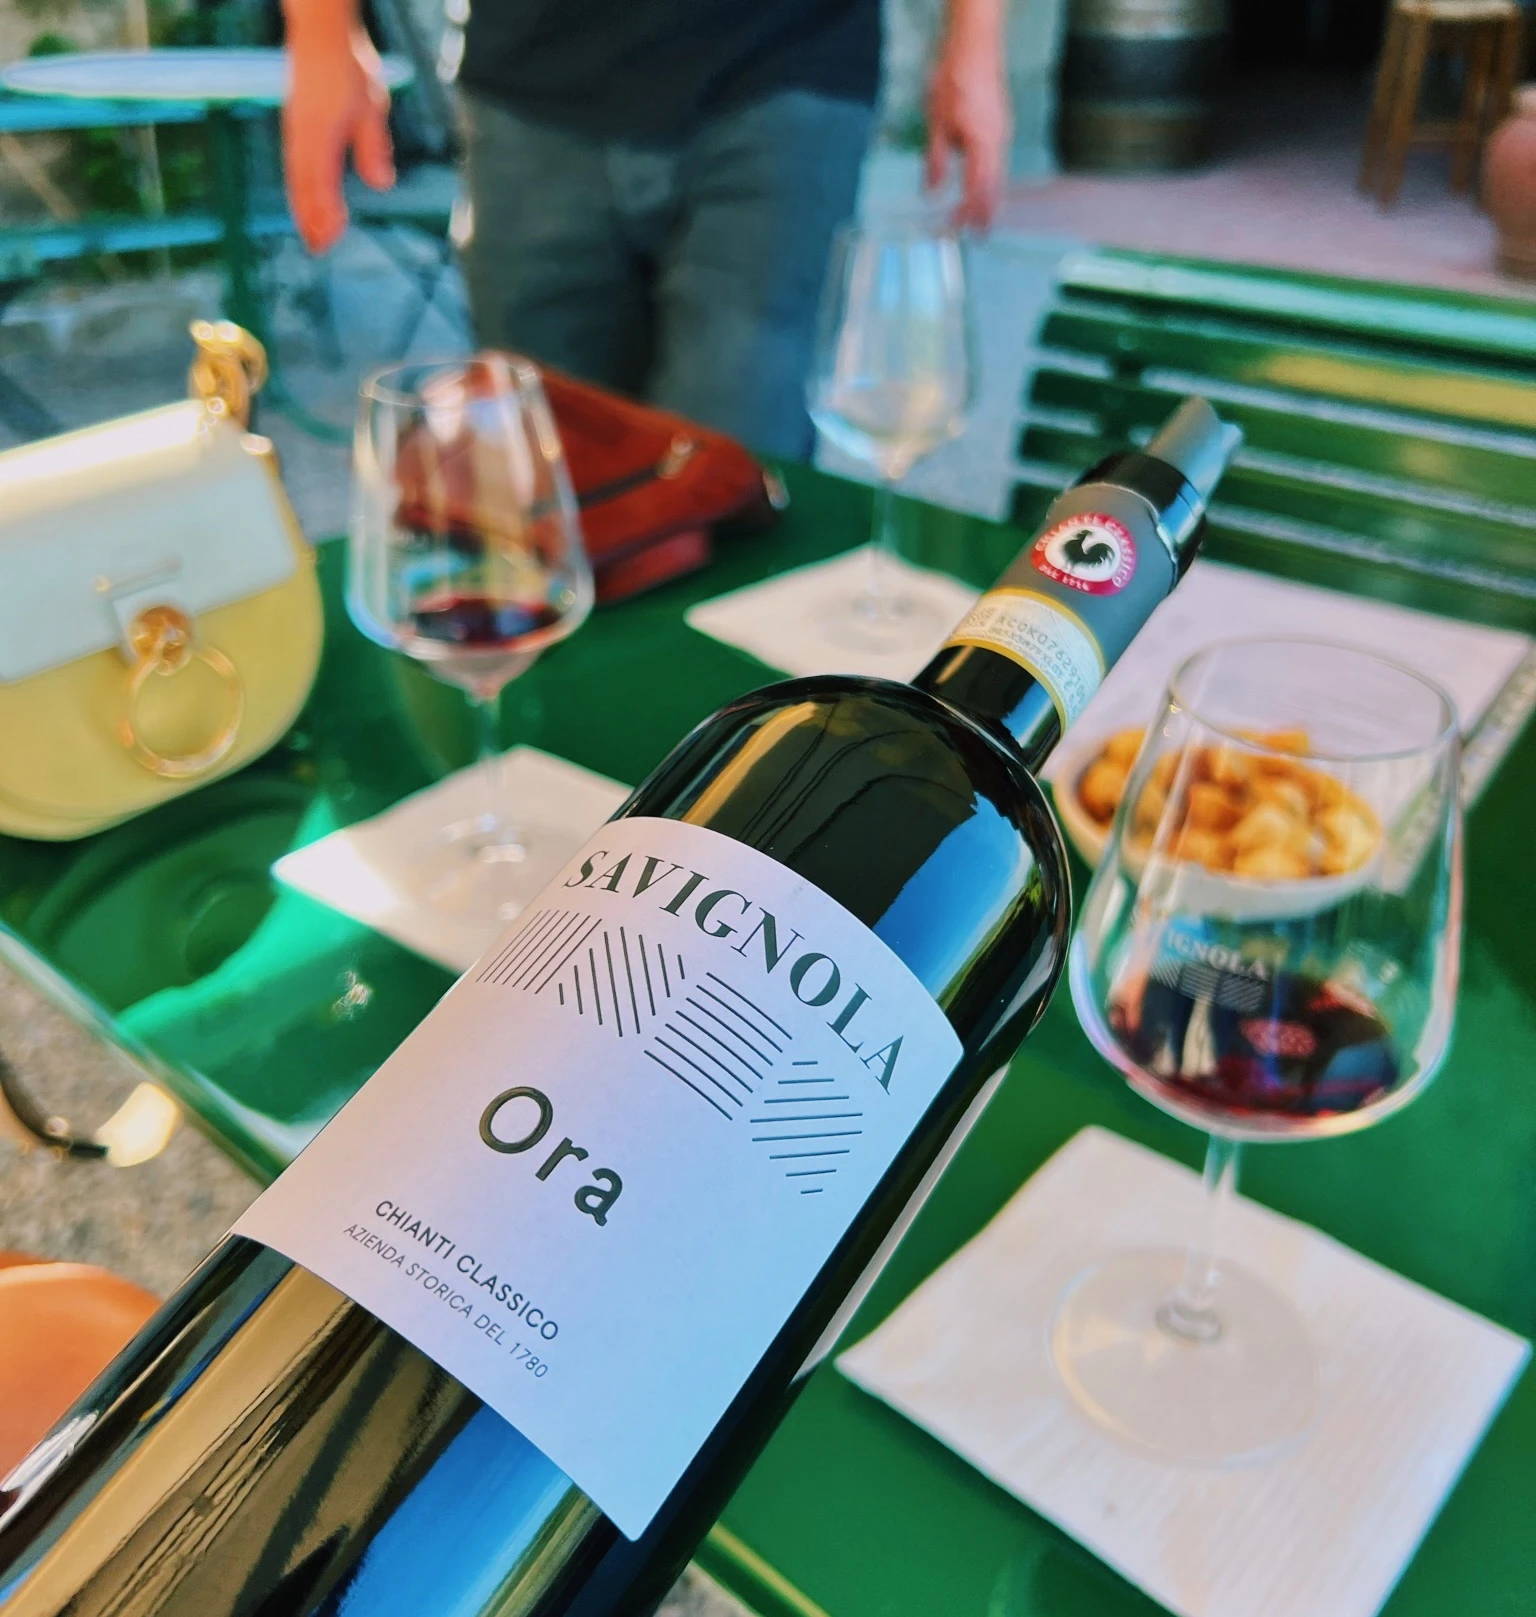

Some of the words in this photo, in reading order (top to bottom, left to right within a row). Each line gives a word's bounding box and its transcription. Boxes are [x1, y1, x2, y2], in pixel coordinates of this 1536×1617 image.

[563, 849, 905, 1096] SAVIGNOLA
[478, 1085, 624, 1228] Ora
[343, 1223, 406, 1269] AZIENDA
[405, 1262, 474, 1320] STORICA
[473, 1313, 506, 1346] DEL
[508, 1342, 549, 1379] 1780
[374, 1200, 457, 1260] CHIANTI
[455, 1254, 560, 1341] CLASSICO
